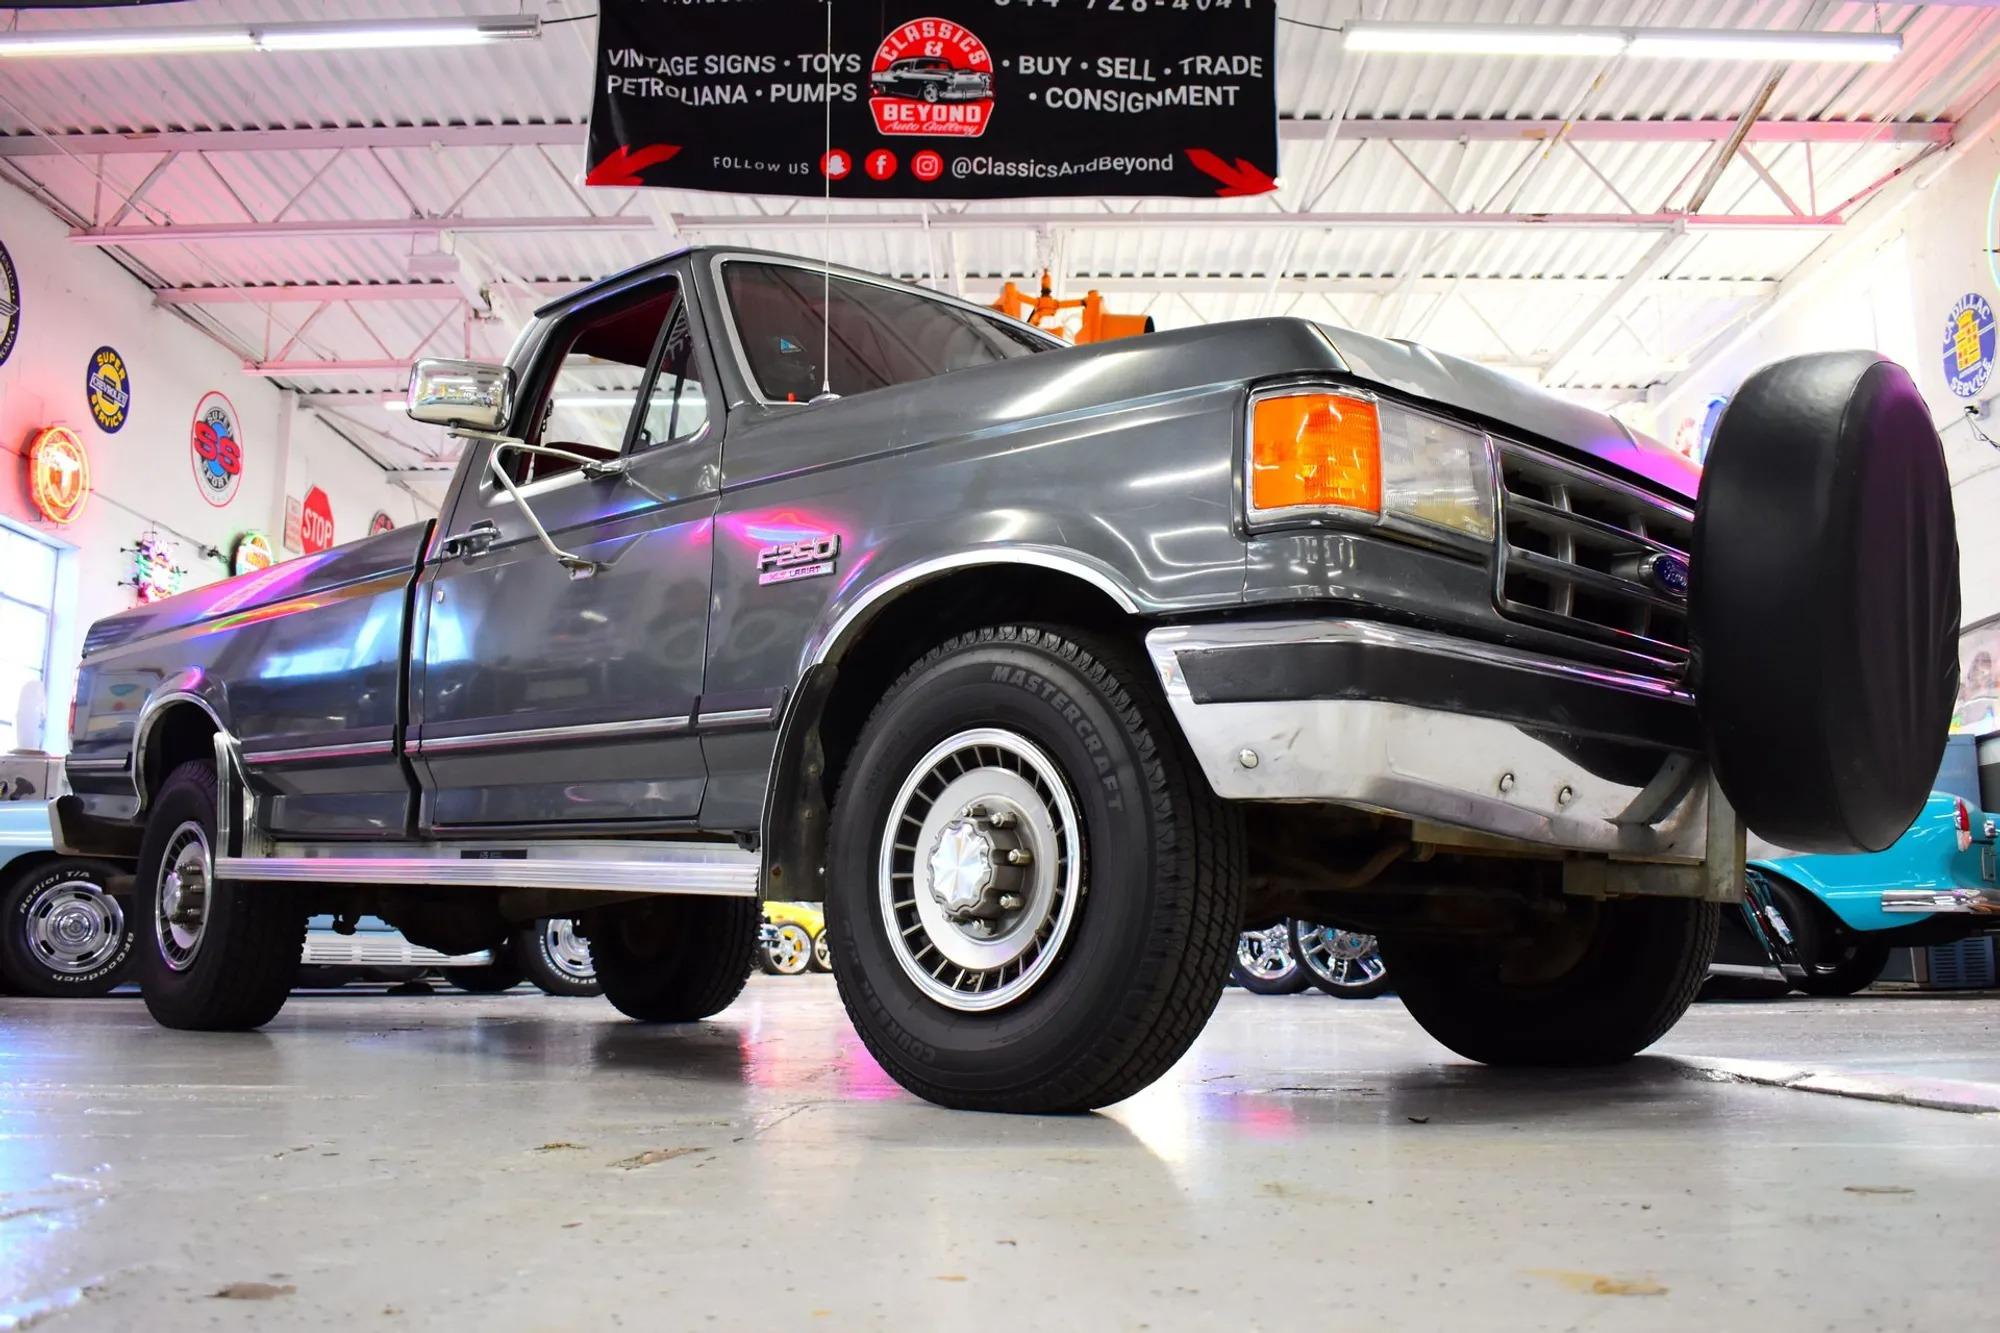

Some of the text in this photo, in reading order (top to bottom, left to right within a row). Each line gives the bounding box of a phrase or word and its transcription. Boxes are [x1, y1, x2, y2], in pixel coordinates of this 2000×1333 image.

[880, 21, 987, 65] CLASSICS
[924, 41, 944, 57] &
[607, 49, 861, 76] VINTAGE SIGNS TOYS
[1018, 55, 1263, 82] BUY SELL TRADE
[607, 75, 857, 106] PETROLIANA PUMPS
[1045, 85, 1240, 114] CONSIGNMENT
[883, 103, 982, 123] BEYOND
[885, 121, 980, 136] Auto Gallery
[713, 157, 809, 175] FOLLOW US
[951, 154, 1173, 179] @ClassicsAndBeyond
[1944, 295, 1990, 344] CADILLAC
[97, 351, 126, 380] SUPER
[1951, 358, 1992, 397] SERVICE
[91, 394, 124, 427] SERVICE
[194, 420, 241, 475] SS
[303, 508, 333, 550] STOP
[789, 566, 821, 577] LARIAT
[991, 664, 1124, 812] MASTERCRAFT
[20, 870, 91, 914] Radial T/A
[52, 931, 135, 983] BFGoodrich
